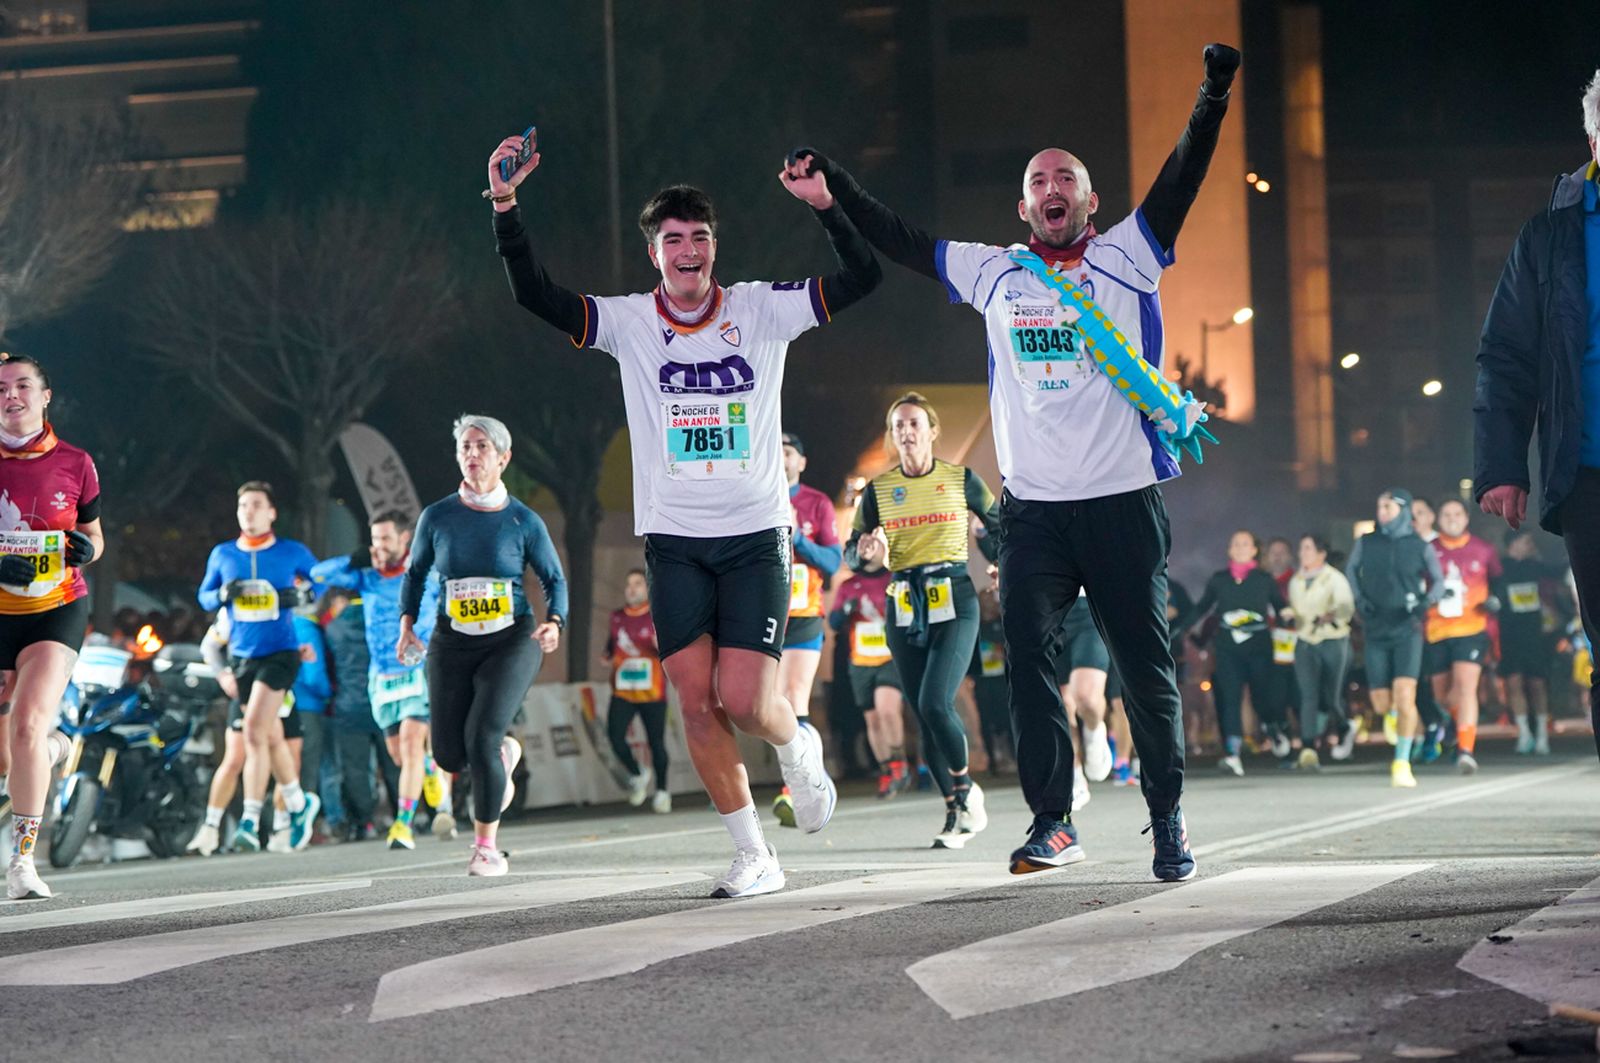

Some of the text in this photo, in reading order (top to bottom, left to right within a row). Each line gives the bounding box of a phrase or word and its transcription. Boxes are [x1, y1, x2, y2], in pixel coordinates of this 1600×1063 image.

[1021, 308, 1043, 317] NOCHE
[1044, 308, 1055, 316] DE
[1013, 319, 1027, 328] SAN
[1015, 328, 1075, 353] 13343
[681, 407, 707, 416] NOCHE
[709, 406, 720, 415] DE
[672, 418, 689, 427] SAN
[682, 427, 735, 452] 7851
[30, 538, 39, 546] DE
[460, 598, 501, 618] 5344
[762, 617, 778, 644] 3
